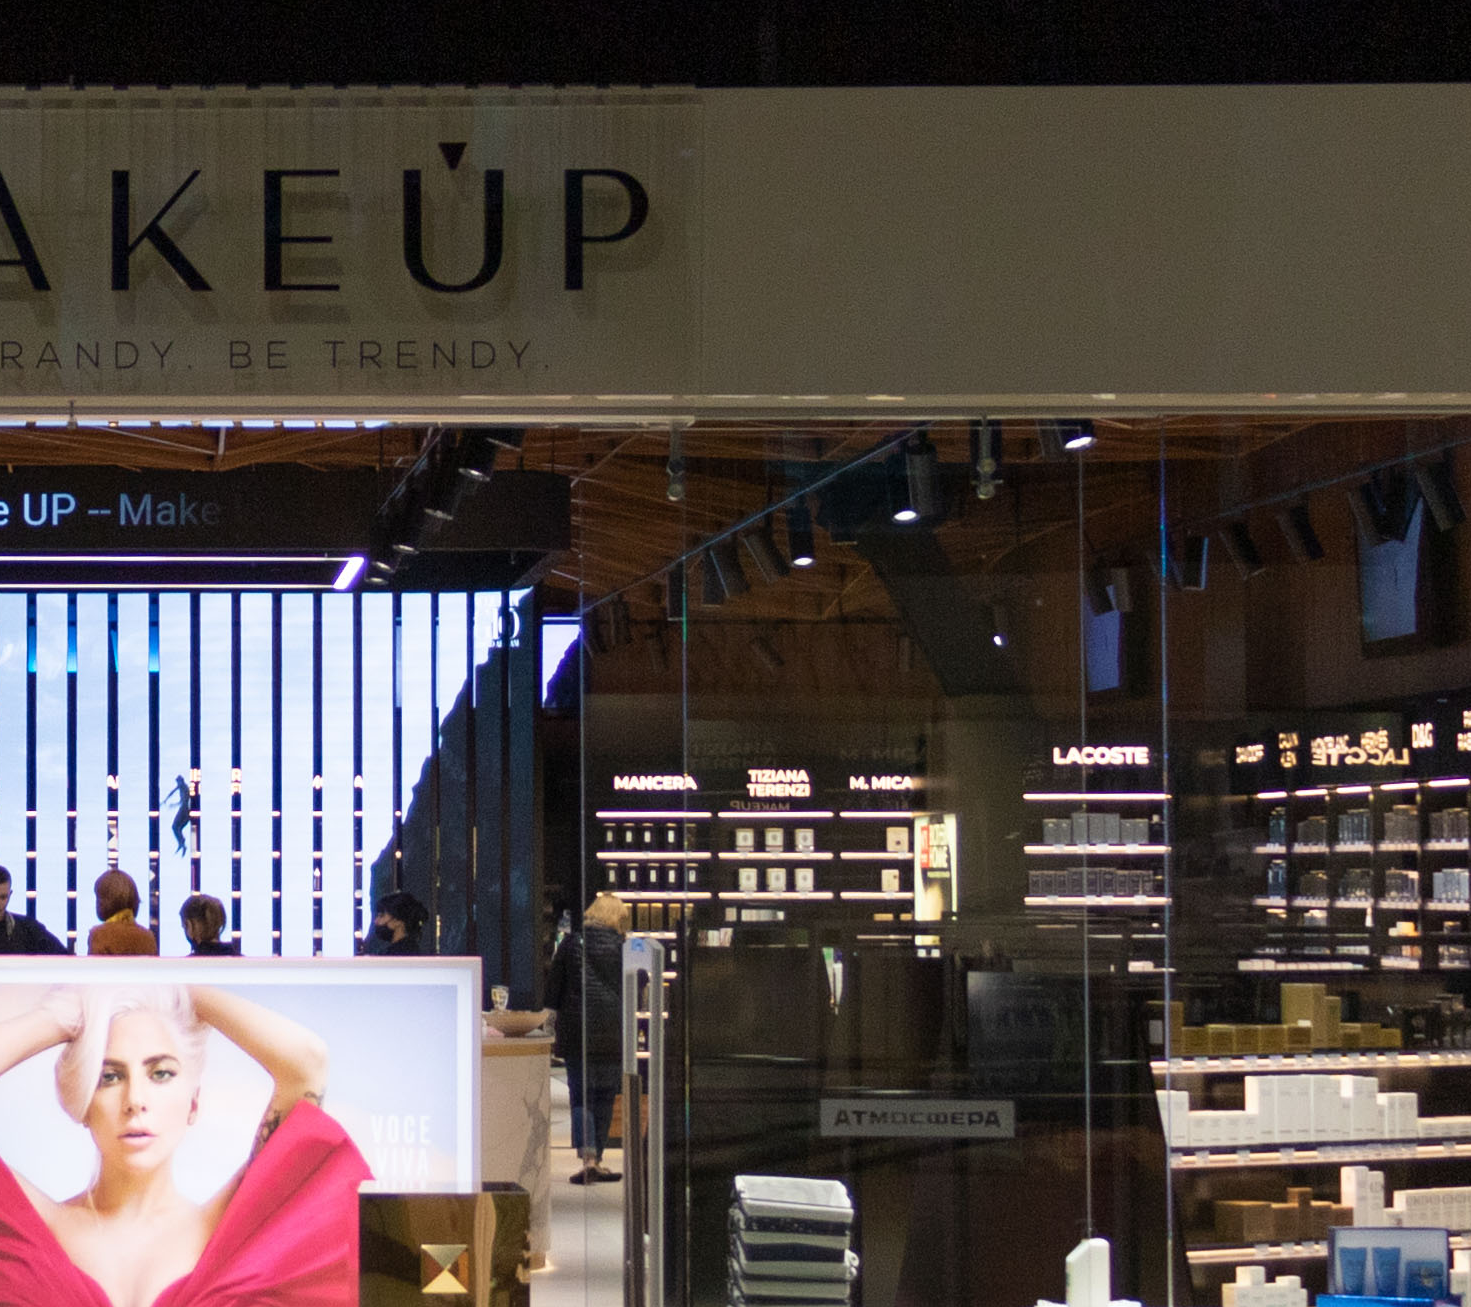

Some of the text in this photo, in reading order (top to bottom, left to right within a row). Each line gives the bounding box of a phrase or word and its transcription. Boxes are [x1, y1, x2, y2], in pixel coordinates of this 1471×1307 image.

[229, 340, 288, 371] BE
[324, 340, 550, 371] TRENDY.
[23, 493, 76, 527] UP
[1411, 721, 1434, 749] D&G
[1052, 746, 1150, 766] LACOSTE
[613, 772, 699, 791] MANCERA
[747, 769, 810, 783] TIZIANA
[849, 775, 869, 791] M.
[746, 783, 811, 798] TERENZI
[834, 1109, 1001, 1128] АТМОСФЕРА
[370, 1114, 432, 1144] VOCE
